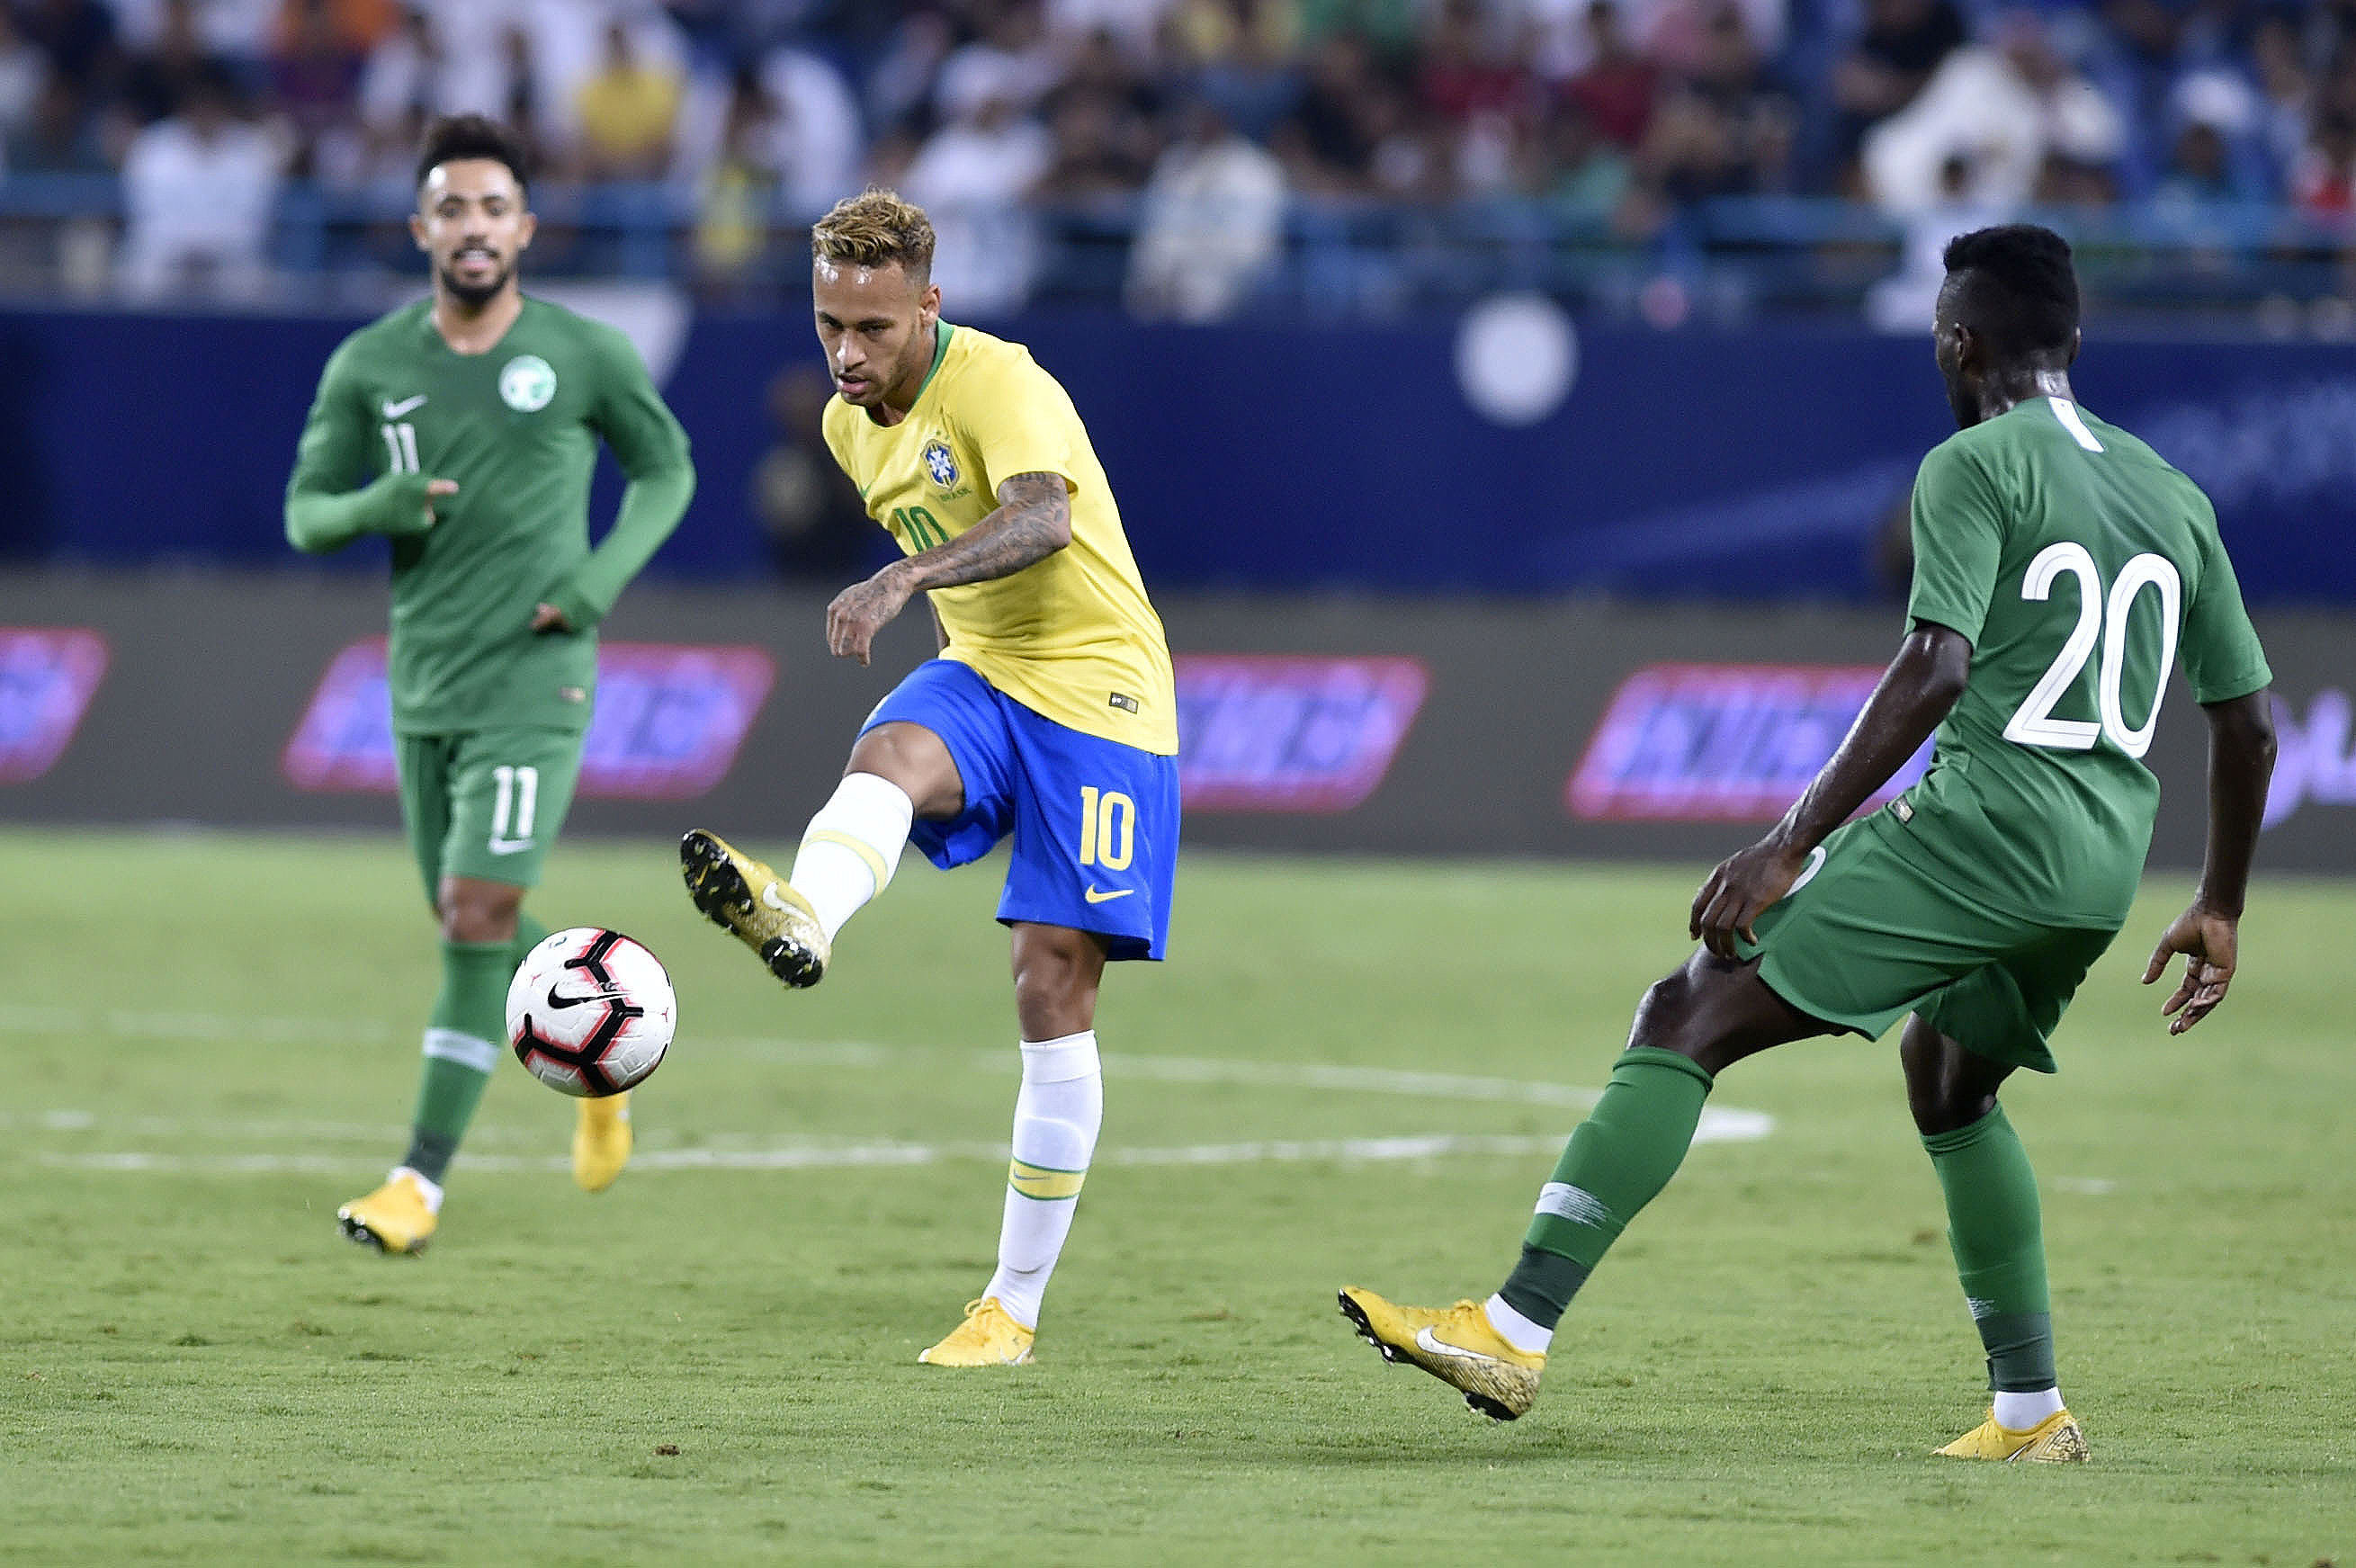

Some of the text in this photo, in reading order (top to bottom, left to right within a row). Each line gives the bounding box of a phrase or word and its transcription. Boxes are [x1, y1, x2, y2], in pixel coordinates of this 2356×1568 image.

[381, 423, 420, 475] 11
[2002, 542, 2181, 758] 20
[492, 766, 538, 838] 11
[1080, 785, 1134, 871] 10
